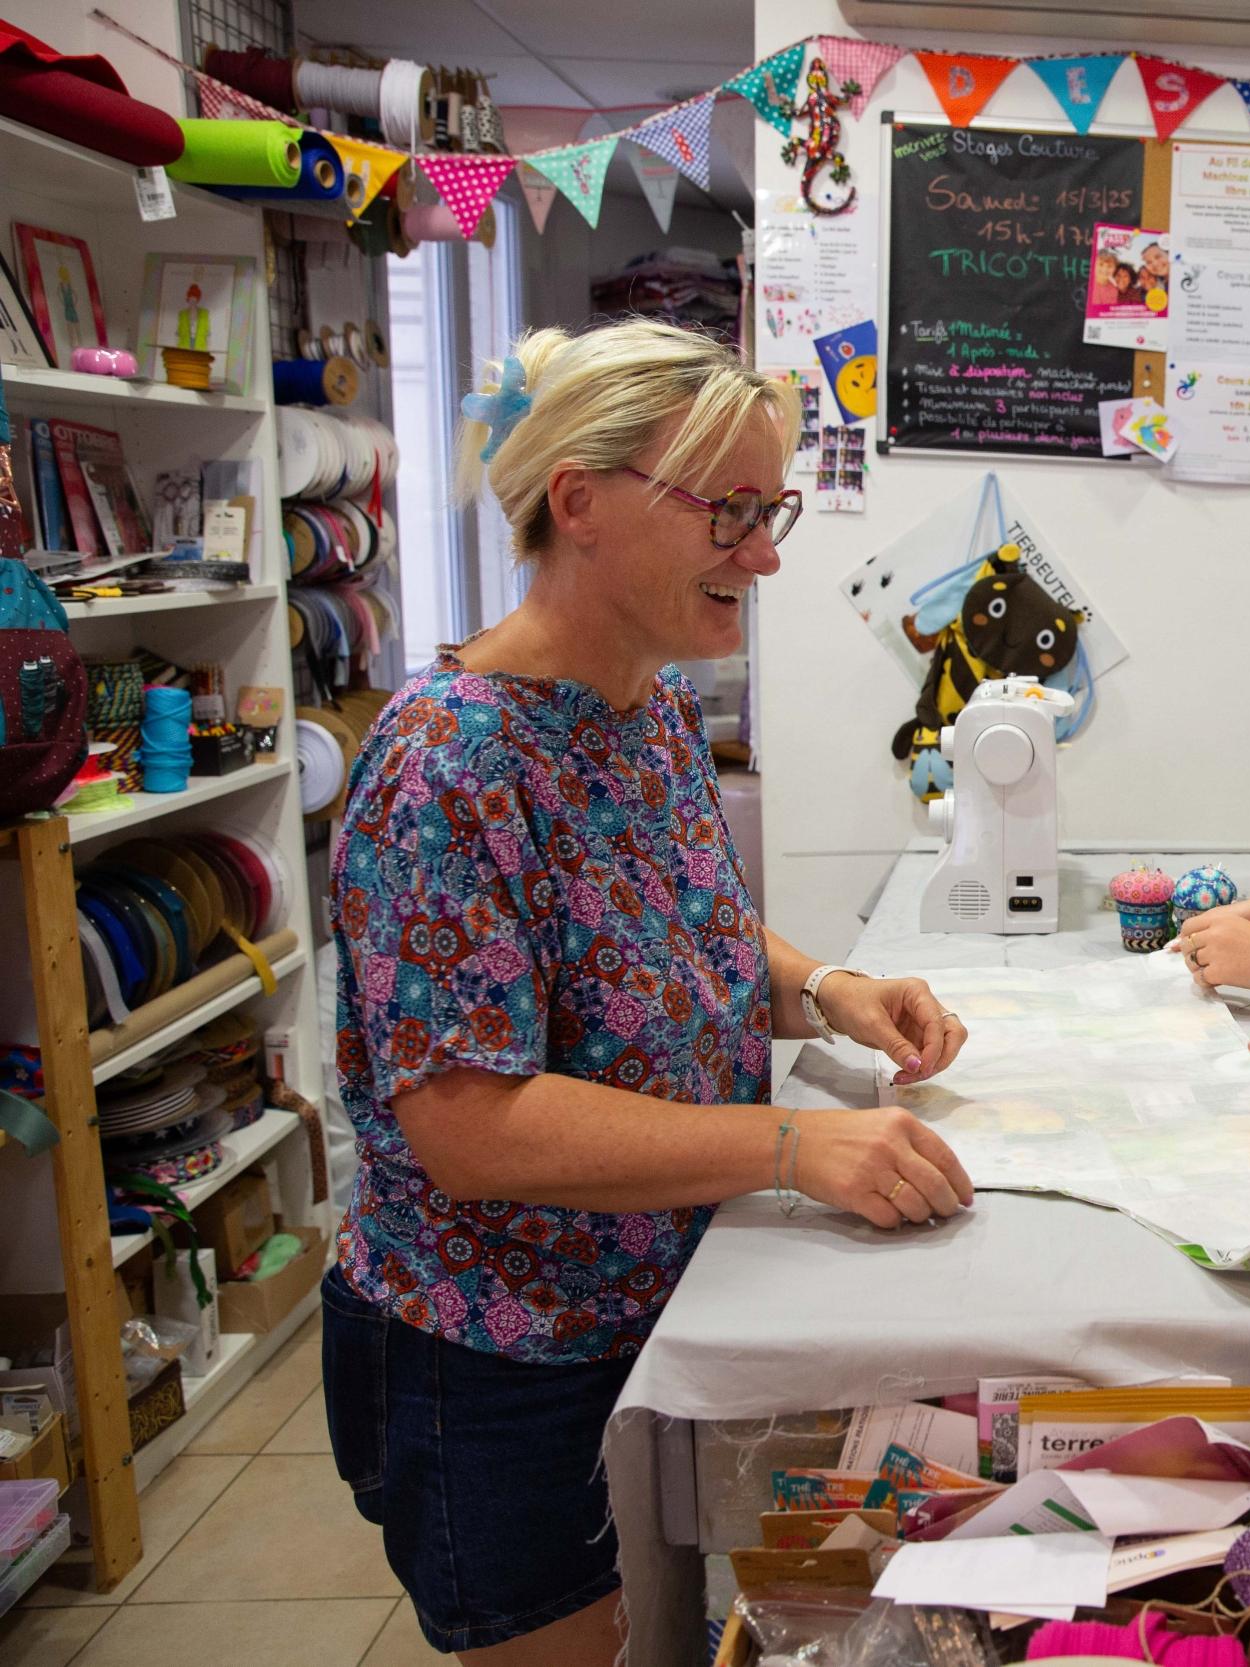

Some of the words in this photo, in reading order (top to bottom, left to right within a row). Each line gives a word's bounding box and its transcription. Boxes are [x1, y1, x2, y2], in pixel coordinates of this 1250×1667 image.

[948, 65, 975, 98] D
[1066, 66, 1091, 104] E
[1154, 72, 1190, 113] S
[952, 130, 1014, 165] Stages
[1018, 136, 1098, 160] Couture
[1209, 157, 1223, 167] Au
[1226, 157, 1239, 168] Fil
[1202, 171, 1249, 183] Machines
[1055, 186, 1133, 214] 15/3/25
[910, 319, 948, 344] Tarifs
[995, 400, 1006, 414] 3
[1041, 1434, 1105, 1452] terre
